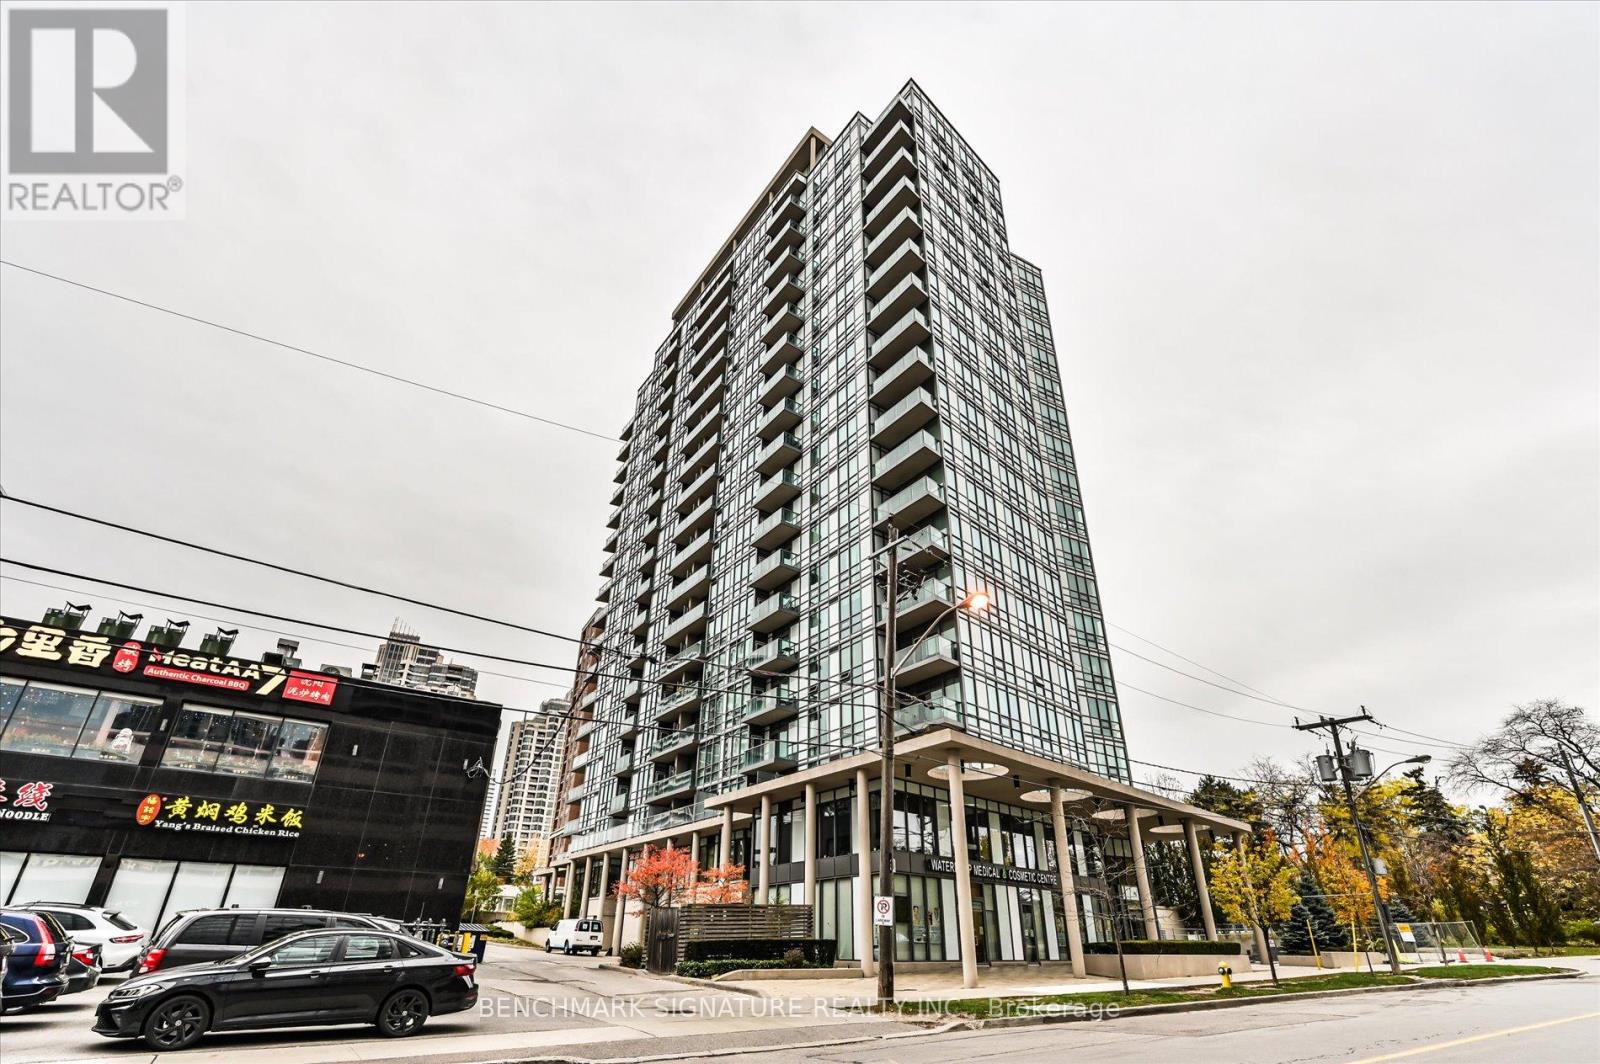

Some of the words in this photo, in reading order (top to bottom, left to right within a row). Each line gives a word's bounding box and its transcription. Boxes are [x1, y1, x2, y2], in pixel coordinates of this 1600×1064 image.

[148, 667, 189, 680] Authentic
[191, 674, 227, 686] Charcoal
[227, 680, 246, 689] BBQ
[0, 777, 53, 811] 线
[165, 796, 303, 828] 黄焖鸡米饭
[154, 819, 191, 831] Yang's
[192, 822, 233, 833] Braised
[234, 826, 276, 836] Chicken
[278, 829, 300, 838] Rice
[973, 865, 1001, 879] MEDICAL
[1008, 869, 1036, 882] COSMETIC
[1037, 873, 1058, 885] CENTRE
